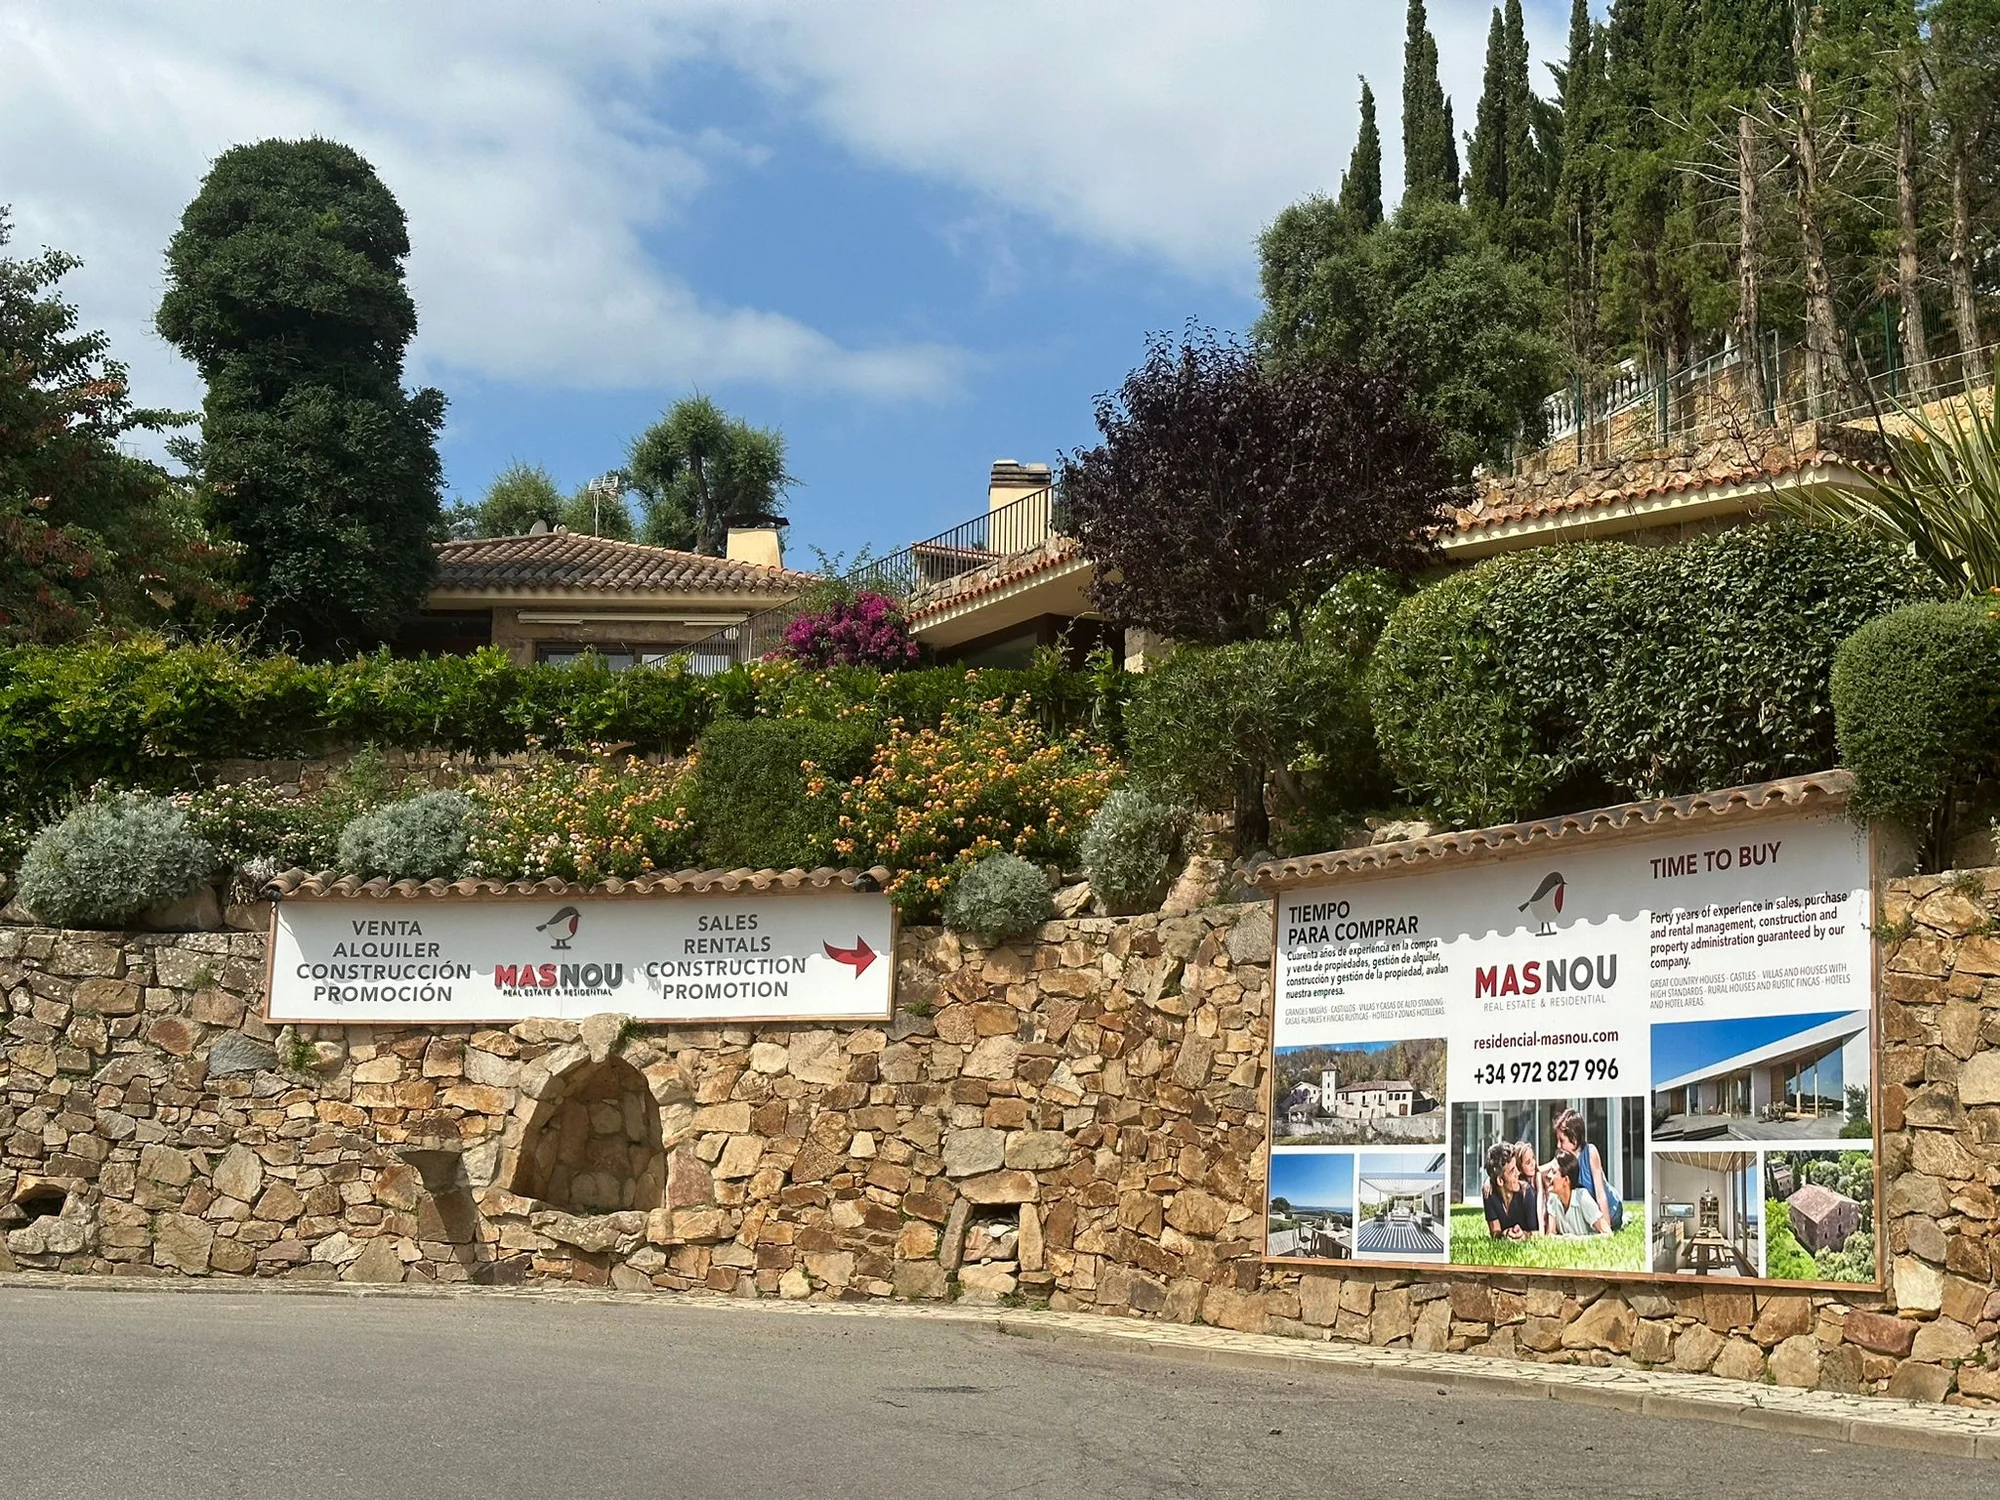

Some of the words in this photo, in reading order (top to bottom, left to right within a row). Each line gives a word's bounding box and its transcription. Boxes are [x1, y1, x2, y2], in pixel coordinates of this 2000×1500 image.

[1650, 853, 1697, 879] TIME
[1704, 851, 1731, 872] TO
[1739, 841, 1782, 867] BUY
[1289, 900, 1350, 924] TIEMPO
[1650, 912, 1673, 925] Forty
[1676, 910, 1699, 925] years
[1701, 904, 1711, 918] of
[1713, 901, 1762, 919] experience
[1764, 898, 1773, 911] in
[1776, 895, 1802, 910] sales,
[1804, 890, 1848, 909] purchase
[352, 921, 423, 936] VENTA
[698, 914, 758, 931] SALES
[1288, 925, 1329, 946] PARA
[1335, 915, 1419, 941] COMPRAR
[1650, 925, 1666, 939] and
[1668, 922, 1693, 937] rental
[1696, 917, 1757, 935] management,
[1759, 910, 1817, 927] construction
[1819, 905, 1837, 921] and
[333, 943, 440, 958] ALQUILER
[684, 936, 771, 954] RENTALS
[1287, 950, 1318, 961] Cuarenta
[1337, 946, 1347, 957] de
[1348, 942, 1390, 957] experiencia
[1391, 943, 1401, 952] en
[1402, 940, 1409, 951] la
[1410, 940, 1438, 951] compra
[1650, 941, 1688, 957] property
[1690, 933, 1754, 950] administration
[1757, 925, 1811, 946] guaranteed
[1813, 924, 1826, 940] by
[1828, 925, 1845, 936] our
[297, 961, 471, 980] CONSTRUCCIÓN
[646, 958, 806, 977] CONSTRUCTION
[1286, 966, 1291, 977] y
[1293, 963, 1312, 973] venta
[1313, 961, 1323, 972] de
[1324, 957, 1370, 973] propiedades,
[1372, 954, 1400, 969] gestión
[1401, 952, 1411, 964] de
[1412, 950, 1441, 965] alquiler,
[1650, 957, 1691, 971] company.
[494, 963, 622, 988] MASNOU
[1286, 973, 1329, 987] construcción
[1330, 975, 1335, 986] y
[1336, 970, 1364, 985] gestión
[1364, 969, 1375, 980] de
[1376, 968, 1383, 979] la
[1384, 964, 1425, 981] propiedad,
[1425, 962, 1449, 975] avalan
[1475, 953, 1617, 999] MASNOU
[1650, 979, 1669, 988] GREAT
[1670, 976, 1699, 987] COUNTRY
[1700, 974, 1725, 984] HOUSES
[1730, 971, 1756, 982] CASTLES
[1762, 969, 1783, 979] VILLAS
[1784, 967, 1799, 977] AND
[1800, 964, 1828, 976] HOUSES
[1829, 963, 1847, 973] WITH
[314, 983, 452, 1002] PROMOCIÓN
[503, 989, 522, 997] REAL
[524, 988, 551, 996] ESTATE
[555, 988, 561, 996] &
[564, 988, 612, 996] RESIDENTIAL
[663, 981, 788, 999] PROMOTION
[1286, 989, 1312, 999] nuestra
[1313, 987, 1345, 999] empresa.
[1650, 989, 1667, 999] HIGH
[1668, 986, 1703, 997] STANDARDS
[1708, 985, 1728, 995] RURAL
[1729, 982, 1756, 992] HOUSES
[1757, 980, 1771, 990] AND
[1772, 978, 1795, 989] RUSTIC
[1796, 976, 1820, 988] FINCAS
[1825, 974, 1851, 985] HOTELS
[1484, 1002, 1504, 1012] REAL
[1507, 999, 1536, 1010] ESTATE
[1540, 998, 1546, 1008] &
[1550, 994, 1606, 1007] RESIDENTIAL
[1650, 1000, 1664, 1009] AND
[1665, 998, 1683, 1008] HOTEL
[1474, 1031, 1619, 1050] residencial-masnou.com
[1474, 1064, 1505, 1085] +34
[1511, 1061, 1542, 1083] 972
[1547, 1060, 1579, 1082] 827
[1585, 1058, 1619, 1080] 996
